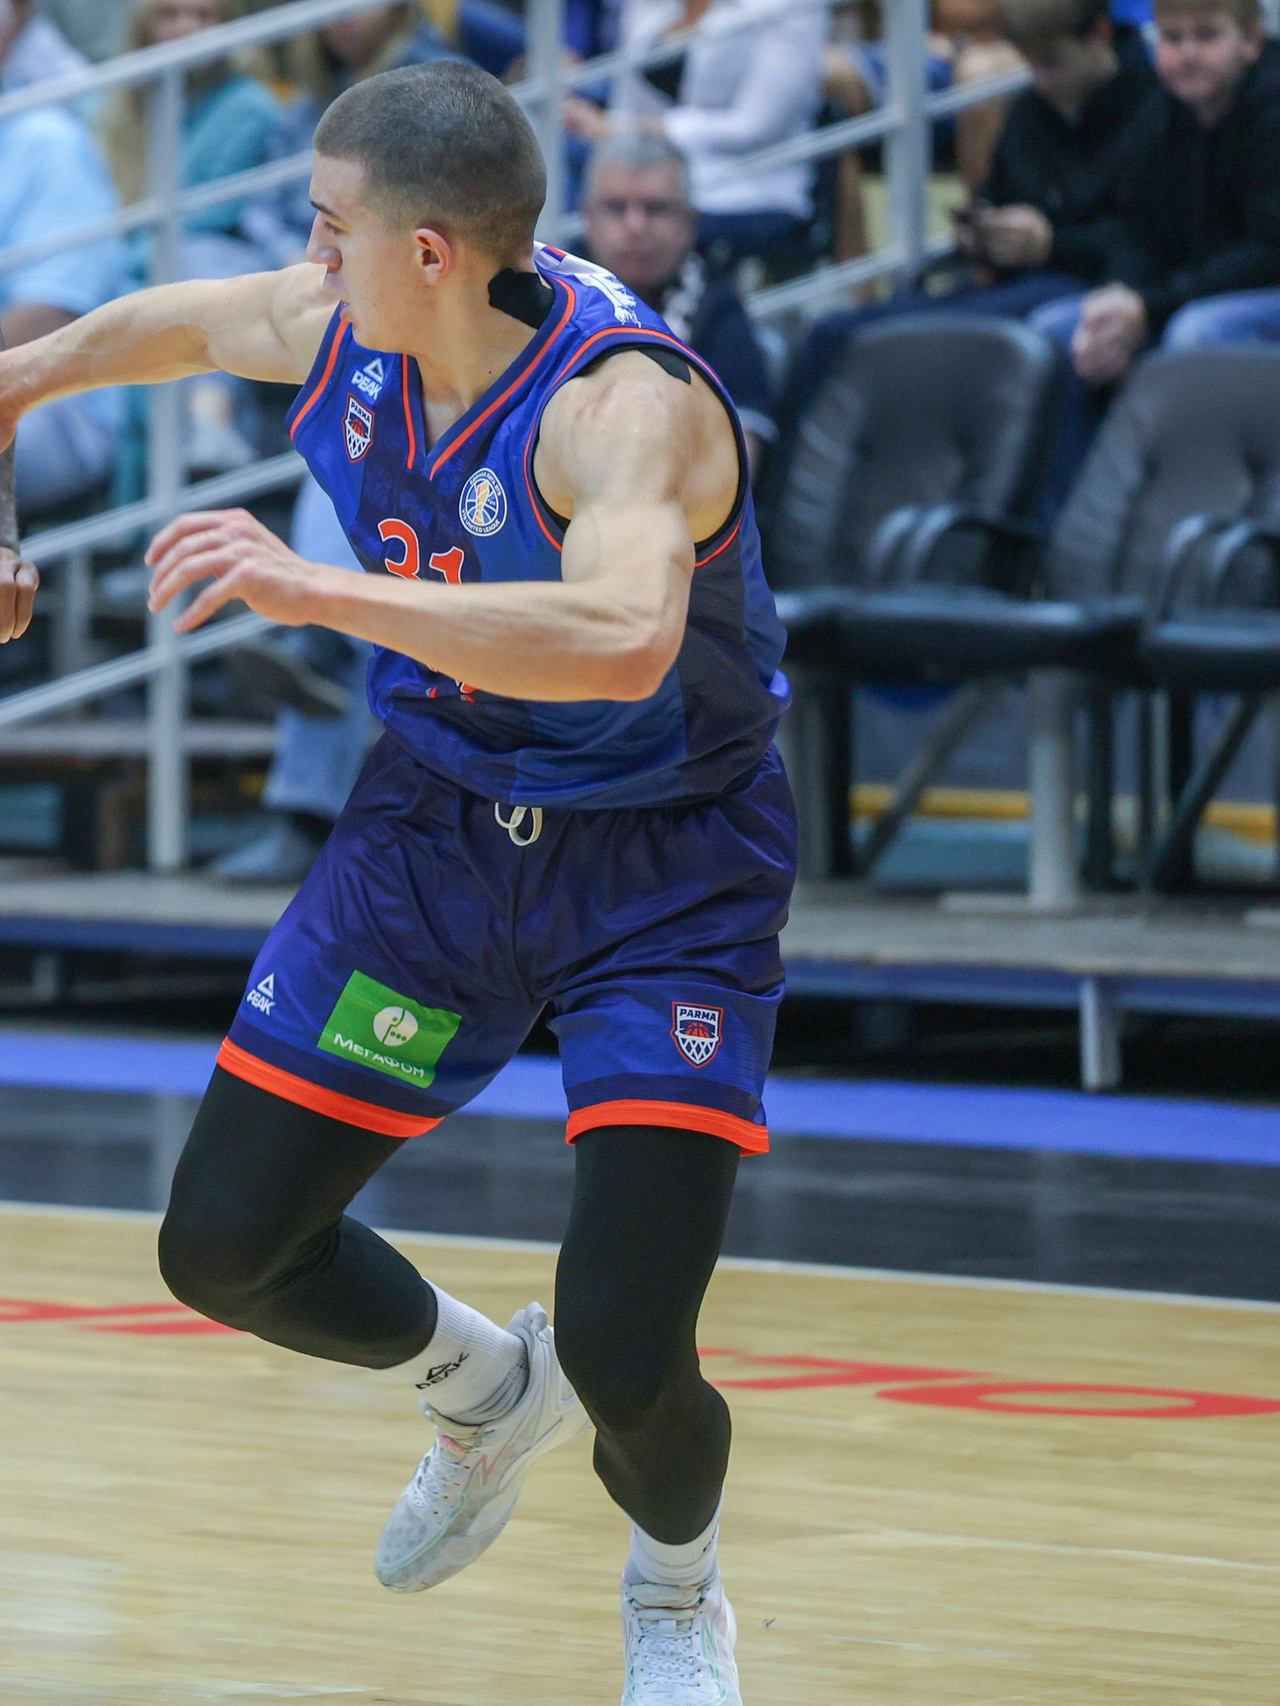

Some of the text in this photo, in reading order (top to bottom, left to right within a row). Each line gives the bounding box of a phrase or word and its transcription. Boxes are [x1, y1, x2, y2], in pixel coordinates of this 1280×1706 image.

[350, 369, 383, 401] PEAK
[350, 401, 371, 424] PARMA
[246, 988, 277, 1016] PEAK
[679, 1008, 717, 1021] PARMA
